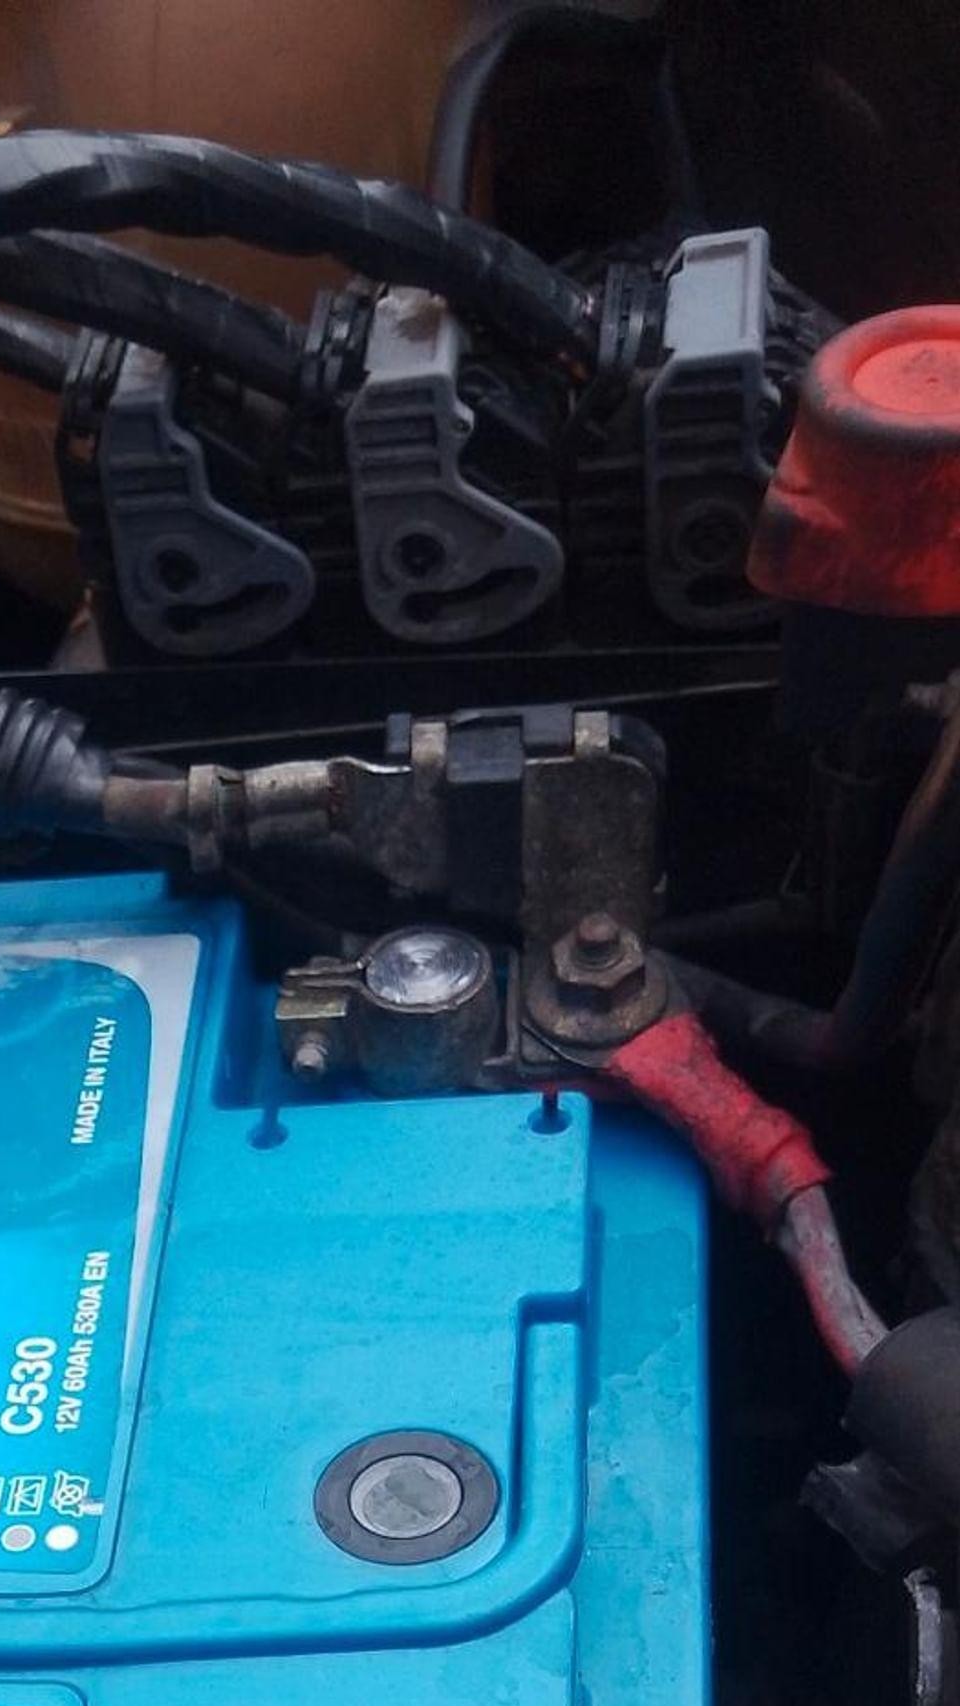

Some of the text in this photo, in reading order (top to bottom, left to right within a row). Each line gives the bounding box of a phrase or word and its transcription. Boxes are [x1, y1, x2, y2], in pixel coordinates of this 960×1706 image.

[70, 1017, 117, 1143] MADE IN ITALY
[0, 1336, 57, 1435] C530
[54, 1251, 110, 1433] 12V 60Ah 530A EN
